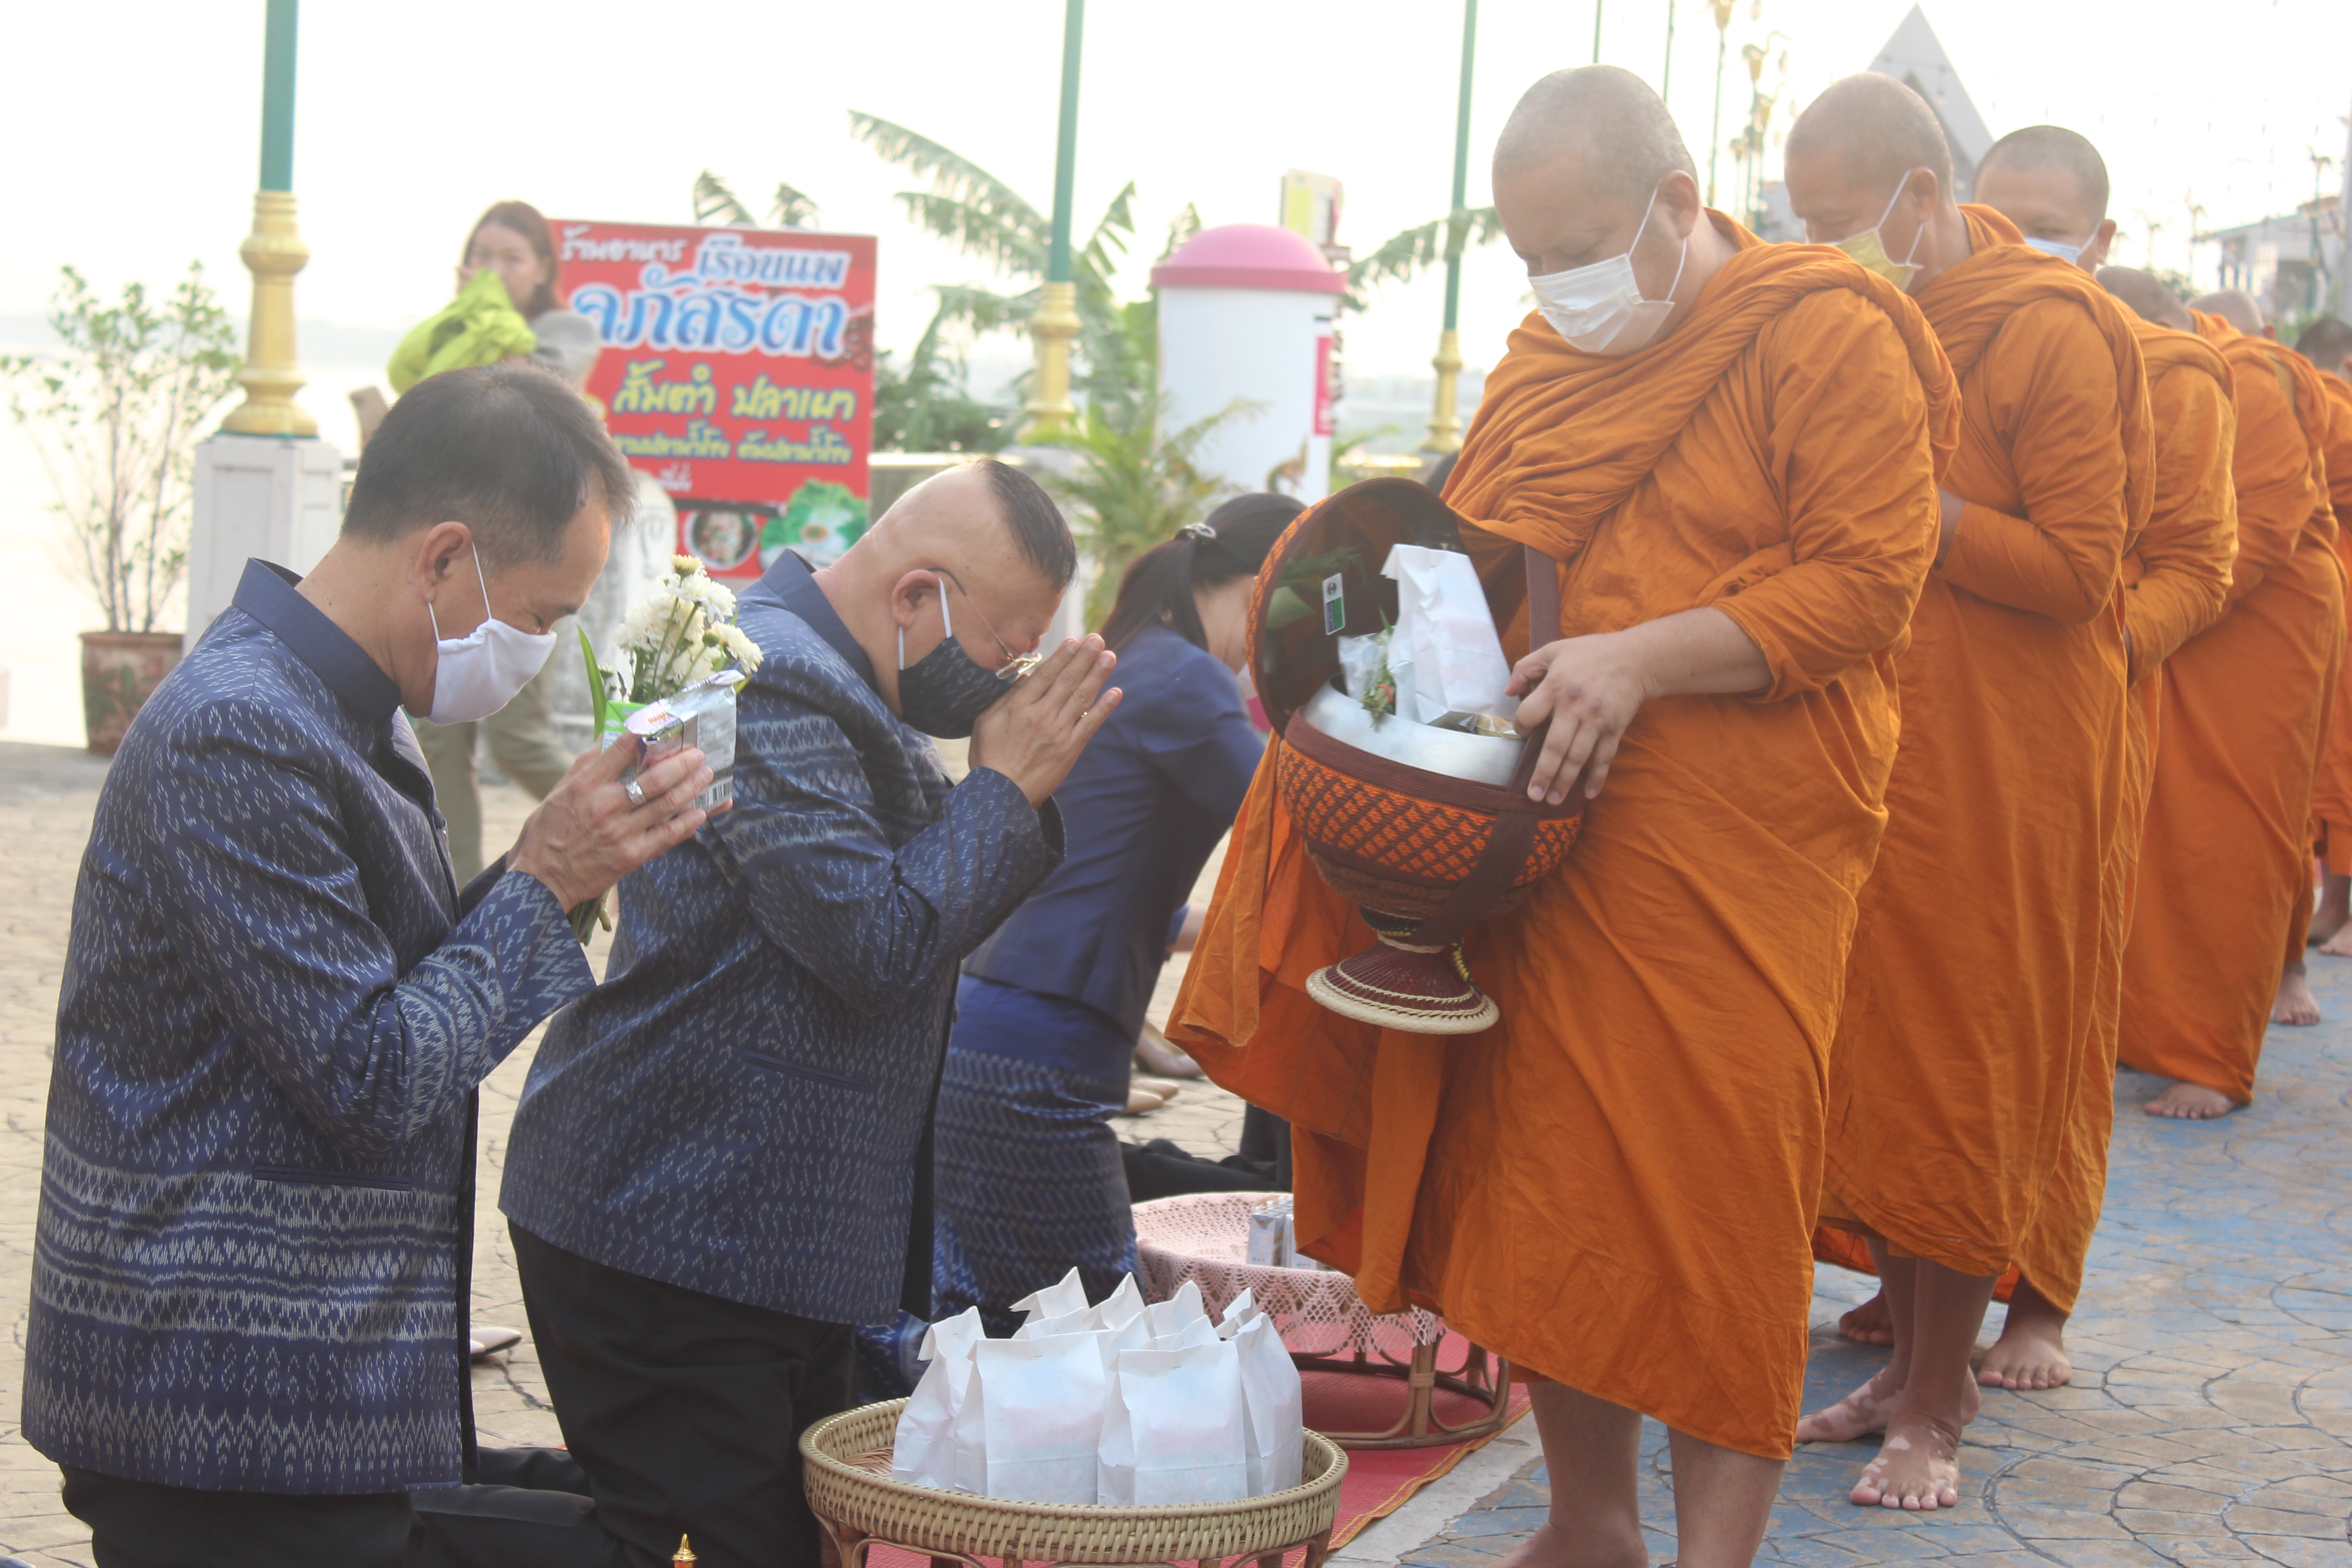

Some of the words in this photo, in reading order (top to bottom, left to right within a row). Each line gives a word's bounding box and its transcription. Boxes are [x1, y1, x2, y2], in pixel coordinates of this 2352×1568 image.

[612, 359, 716, 414] ส้มตำ
[730, 374, 856, 422] ปลาเผา
